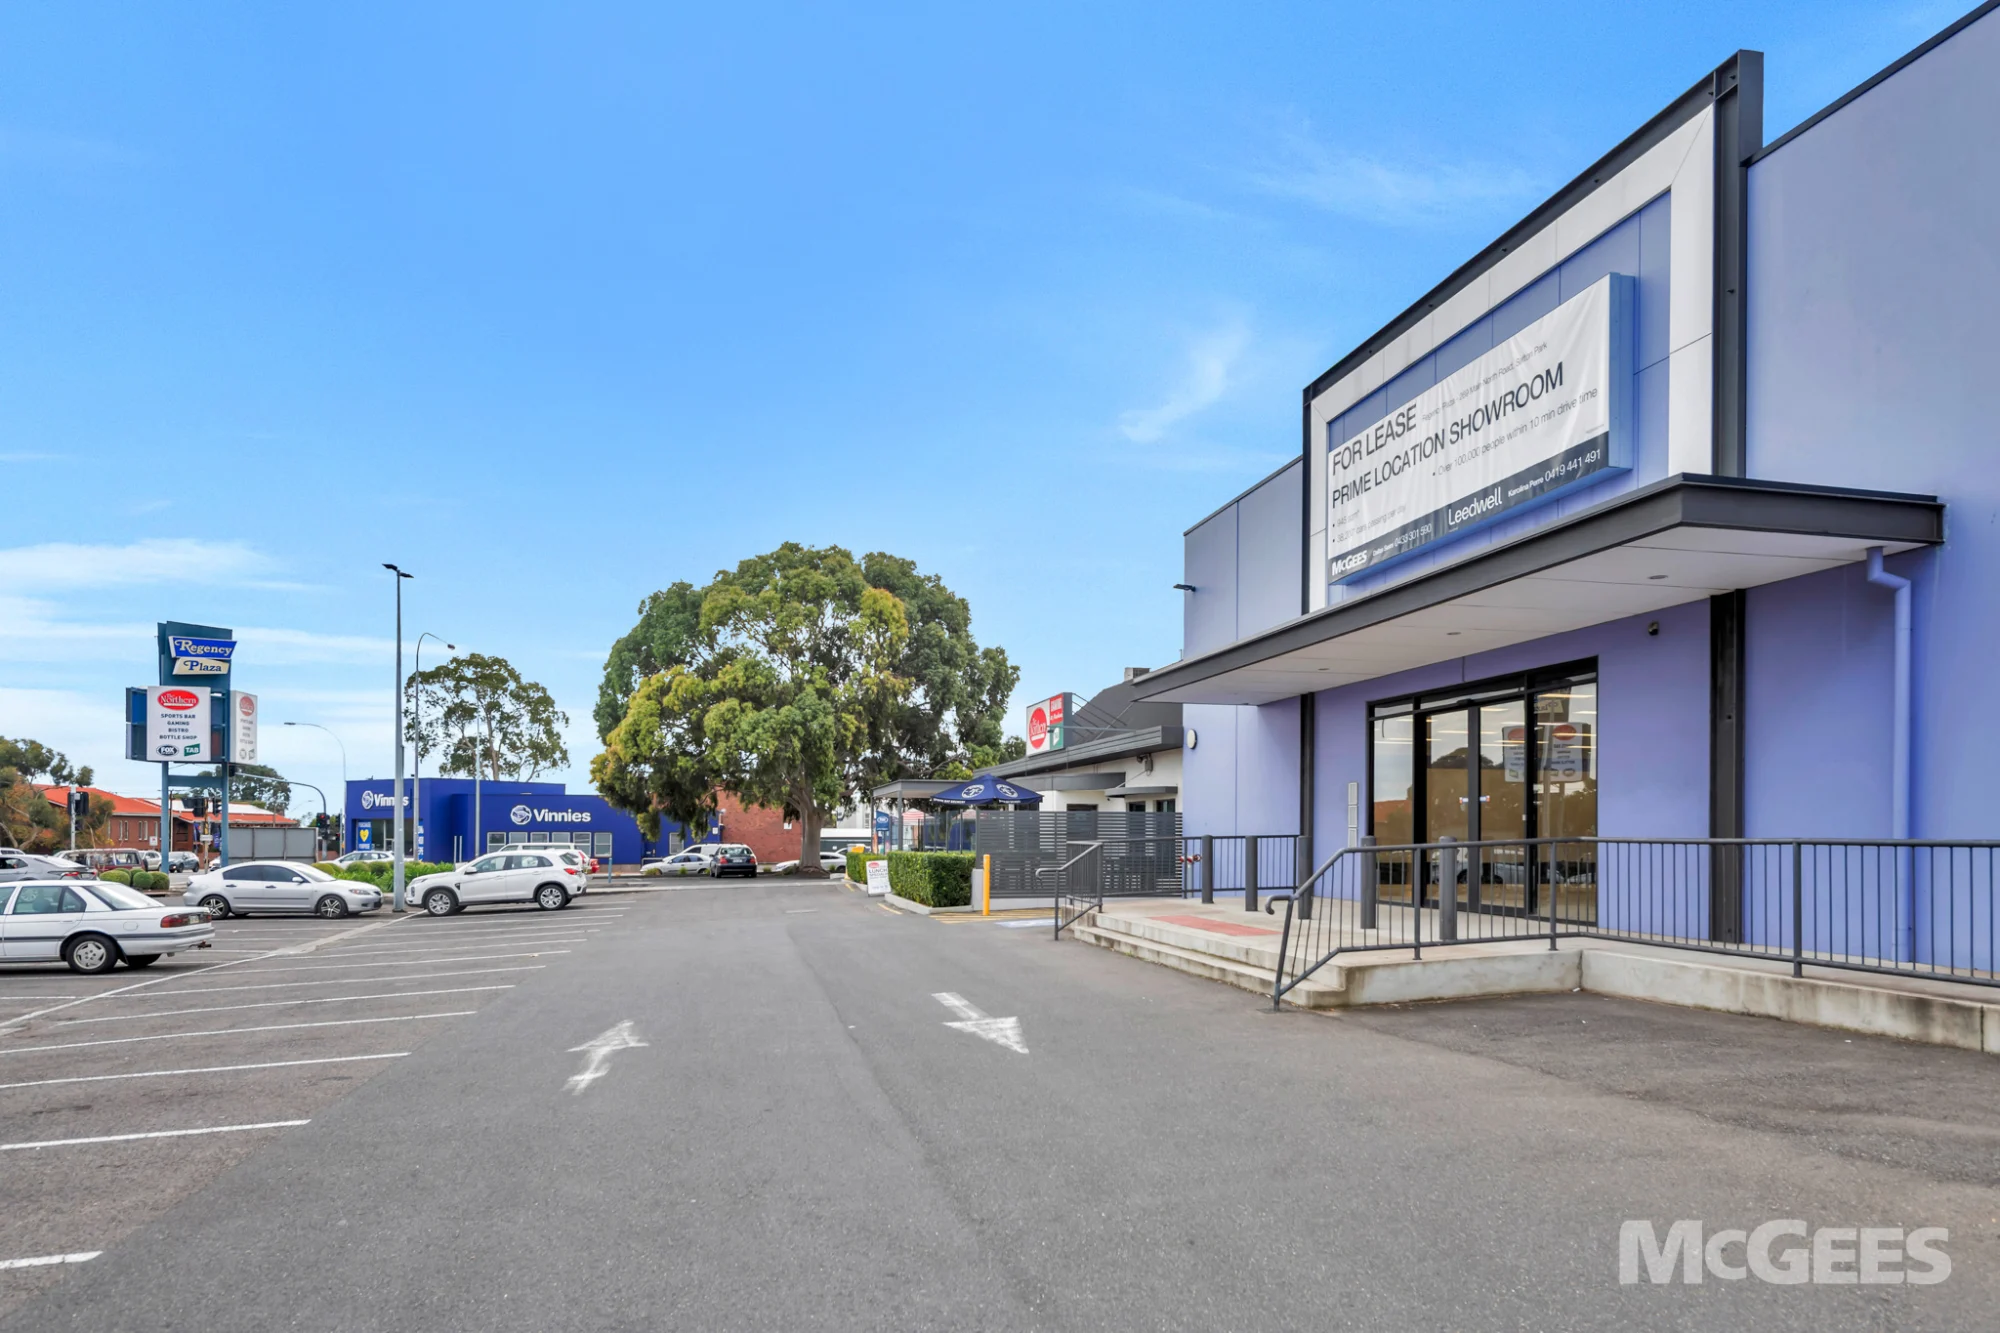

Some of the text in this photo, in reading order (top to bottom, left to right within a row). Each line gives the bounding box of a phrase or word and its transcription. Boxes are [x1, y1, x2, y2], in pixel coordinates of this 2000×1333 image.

[1333, 361, 1563, 508] PRIME LOCATION SHOWROOM
[1333, 404, 1416, 476] FOR LEASE
[1438, 461, 1452, 476] Over
[1481, 435, 1505, 455] people
[1506, 424, 1528, 440] within
[1529, 416, 1540, 430] 10
[1541, 408, 1556, 423] min
[1556, 397, 1577, 416] drive
[1579, 387, 1598, 404] time
[1545, 463, 1566, 482] 0419
[1566, 457, 1583, 472] 441
[1584, 448, 1601, 464] 491
[1448, 486, 1503, 525] Leedwell
[1332, 550, 1368, 576] McGEES
[174, 639, 233, 656] Regency
[183, 660, 222, 671] Plaza
[160, 695, 197, 704] Northern
[374, 793, 409, 807] Vinns
[533, 808, 592, 822] Vinnies
